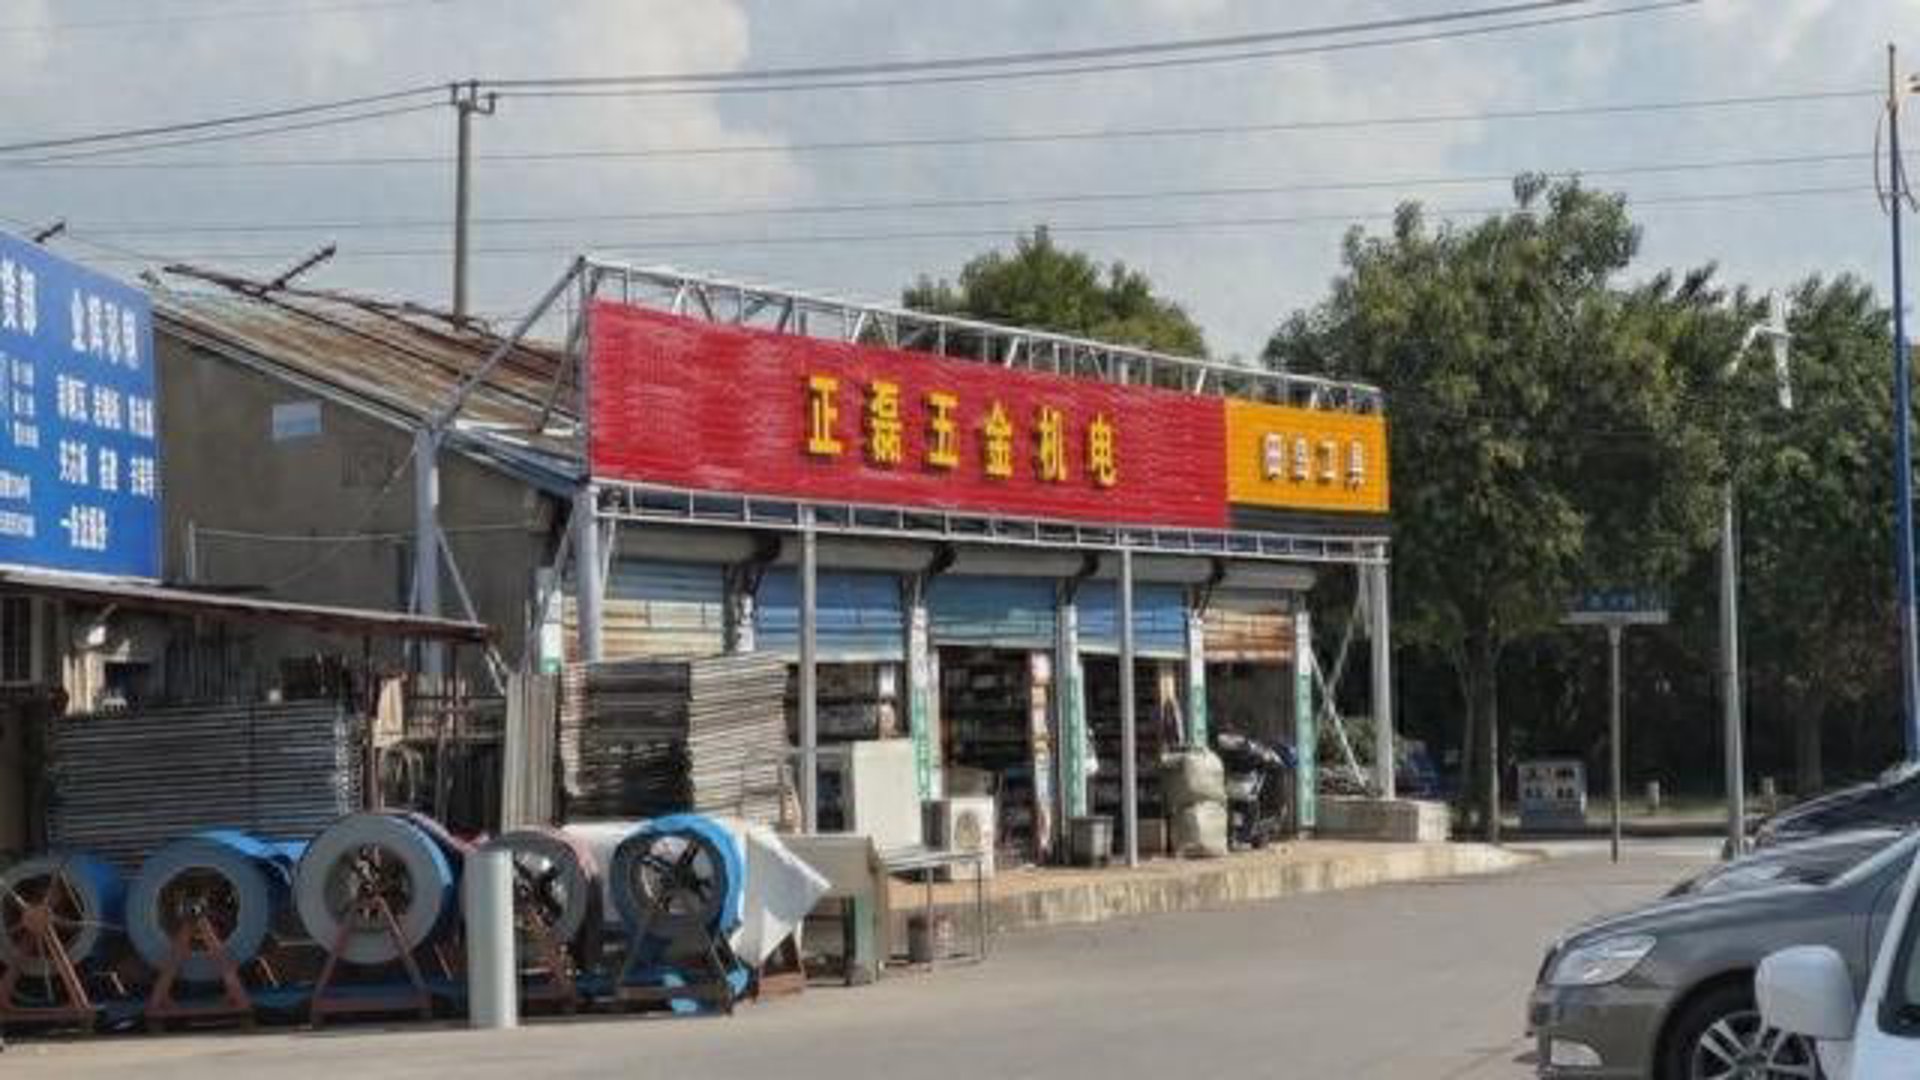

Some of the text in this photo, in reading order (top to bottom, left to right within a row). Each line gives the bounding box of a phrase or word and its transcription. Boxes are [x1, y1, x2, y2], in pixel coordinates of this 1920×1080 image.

[808, 376, 1118, 487] 正磊五金机电
